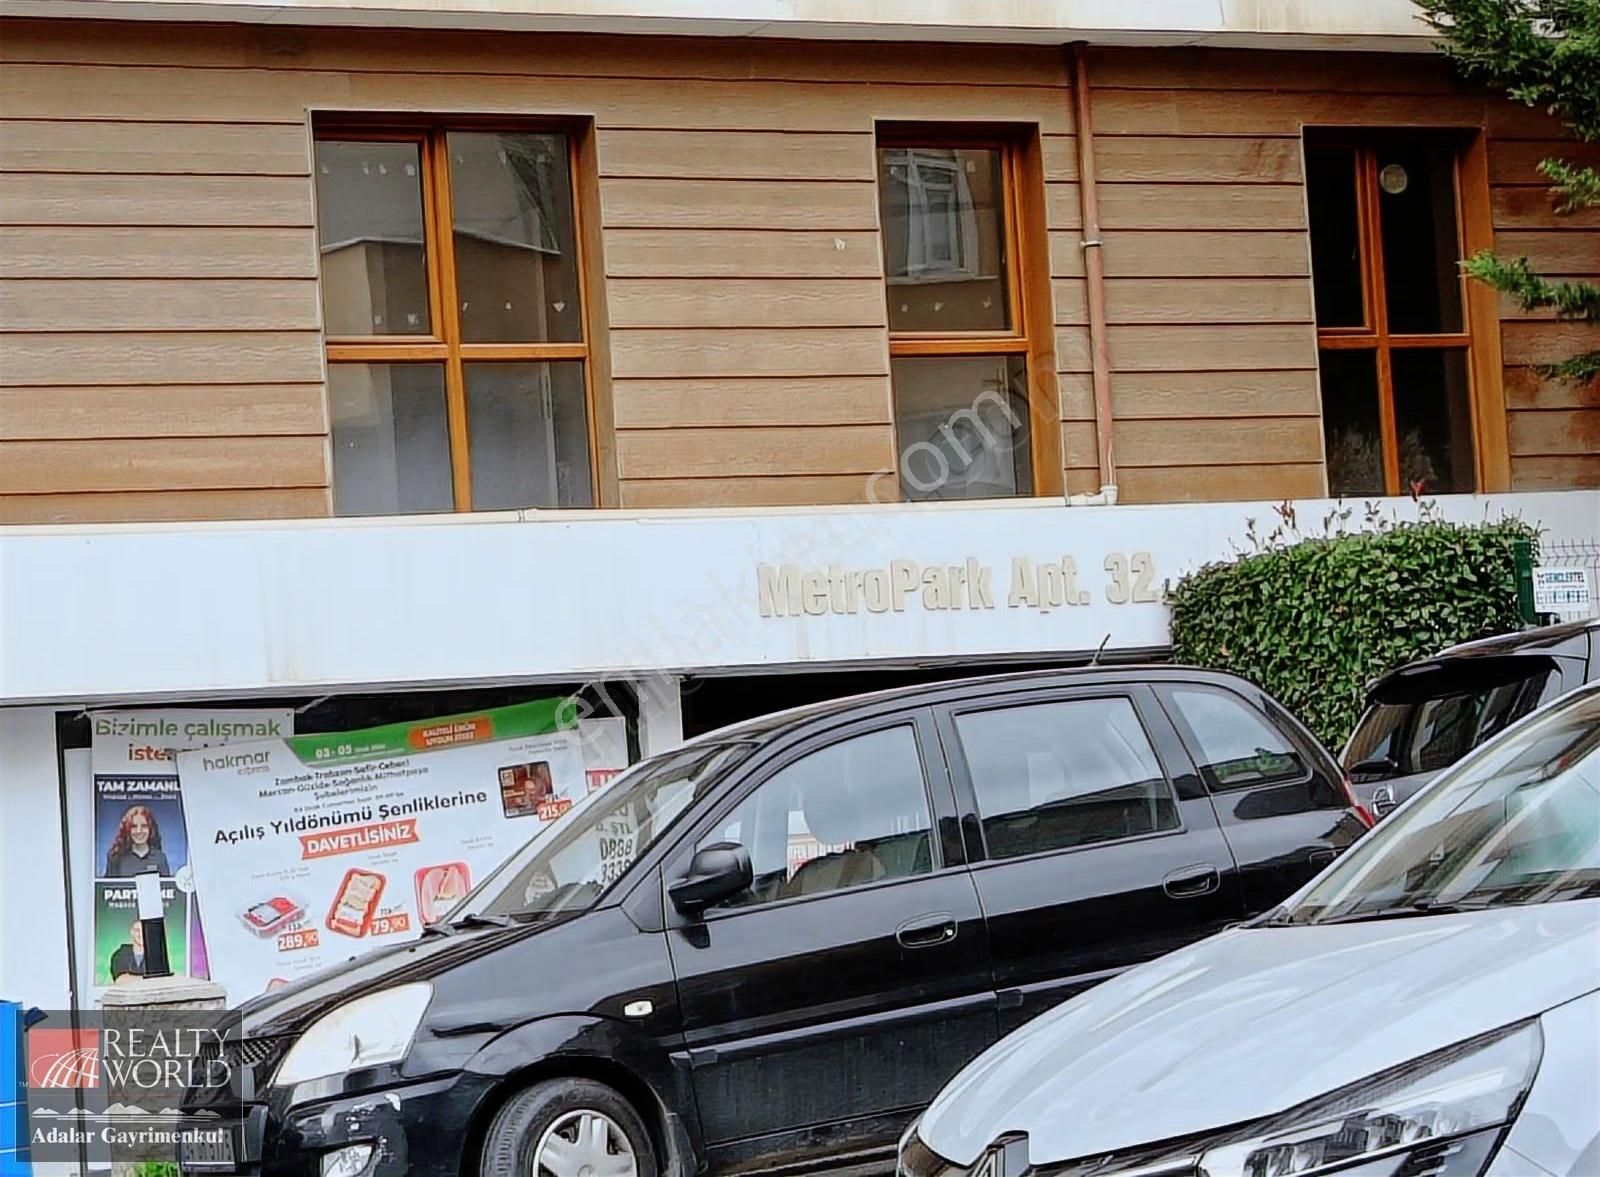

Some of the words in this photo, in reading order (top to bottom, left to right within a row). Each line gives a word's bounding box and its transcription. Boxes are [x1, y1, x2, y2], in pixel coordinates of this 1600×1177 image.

[757, 556, 994, 617] MetroPark
[1008, 554, 1091, 614] Apt.
[96, 718, 179, 736] Bizimle
[184, 718, 281, 741] çalışmak
[203, 752, 271, 771] hakmar
[97, 781, 125, 792] TAM
[127, 780, 181, 792] ZAMANL
[214, 824, 265, 845] Açılış
[270, 806, 373, 835] Yıldönümü
[379, 790, 488, 820] Şenliklerine
[308, 823, 412, 854] DAVETLİSİNİZ
